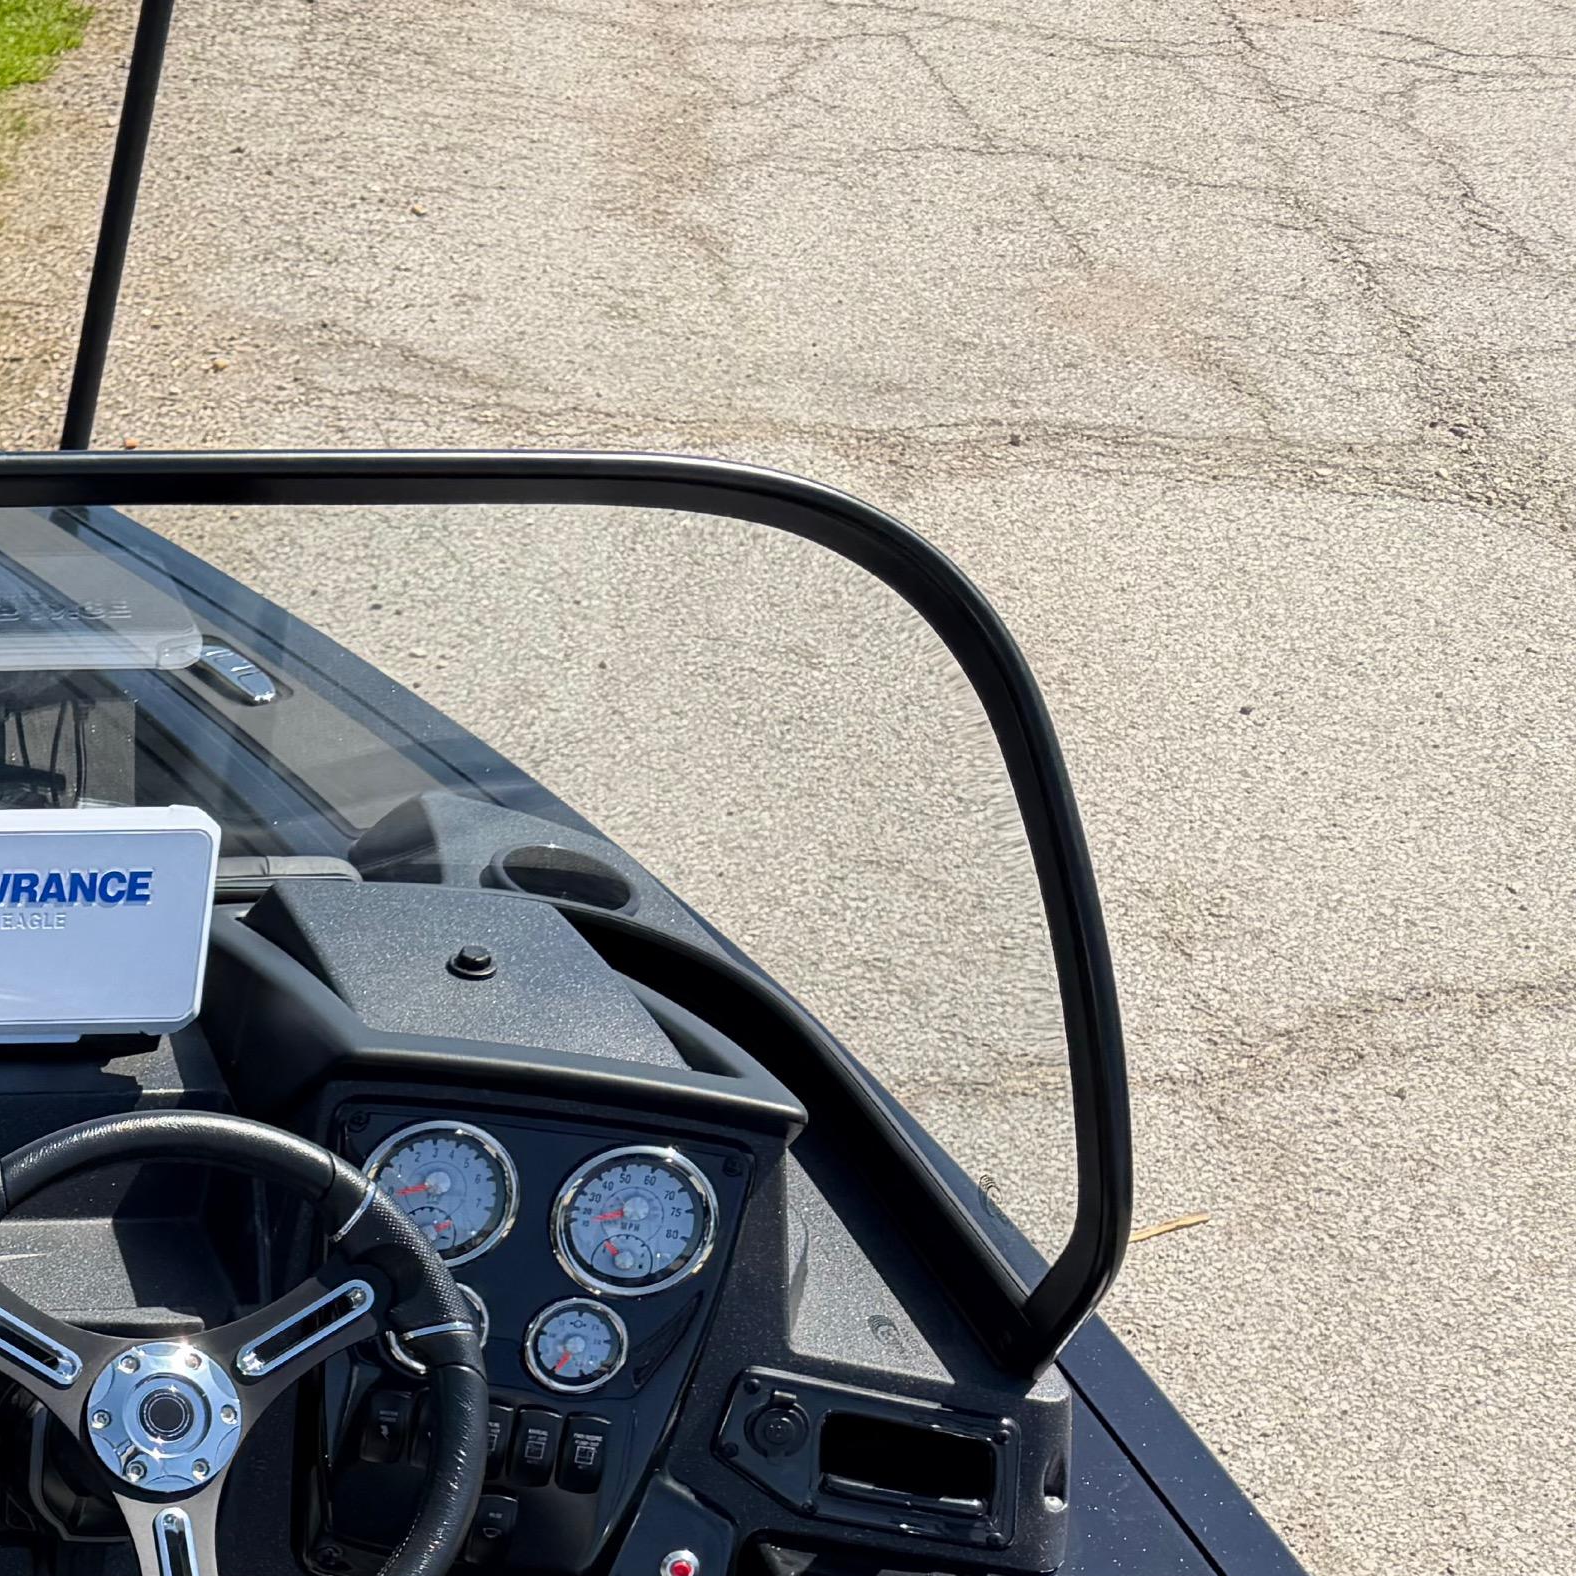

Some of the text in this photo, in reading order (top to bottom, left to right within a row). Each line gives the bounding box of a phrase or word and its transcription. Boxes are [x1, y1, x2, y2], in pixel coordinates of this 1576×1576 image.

[0, 911, 67, 931] EAGLE
[414, 1152, 421, 1163] 2
[448, 1149, 455, 1160] 4
[619, 1173, 632, 1185] 50
[644, 1175, 657, 1186] 60
[602, 1180, 614, 1191] 40
[588, 1191, 602, 1203] 30
[663, 1190, 676, 1201] 70
[670, 1207, 682, 1217] 75
[665, 1229, 679, 1240] 80
